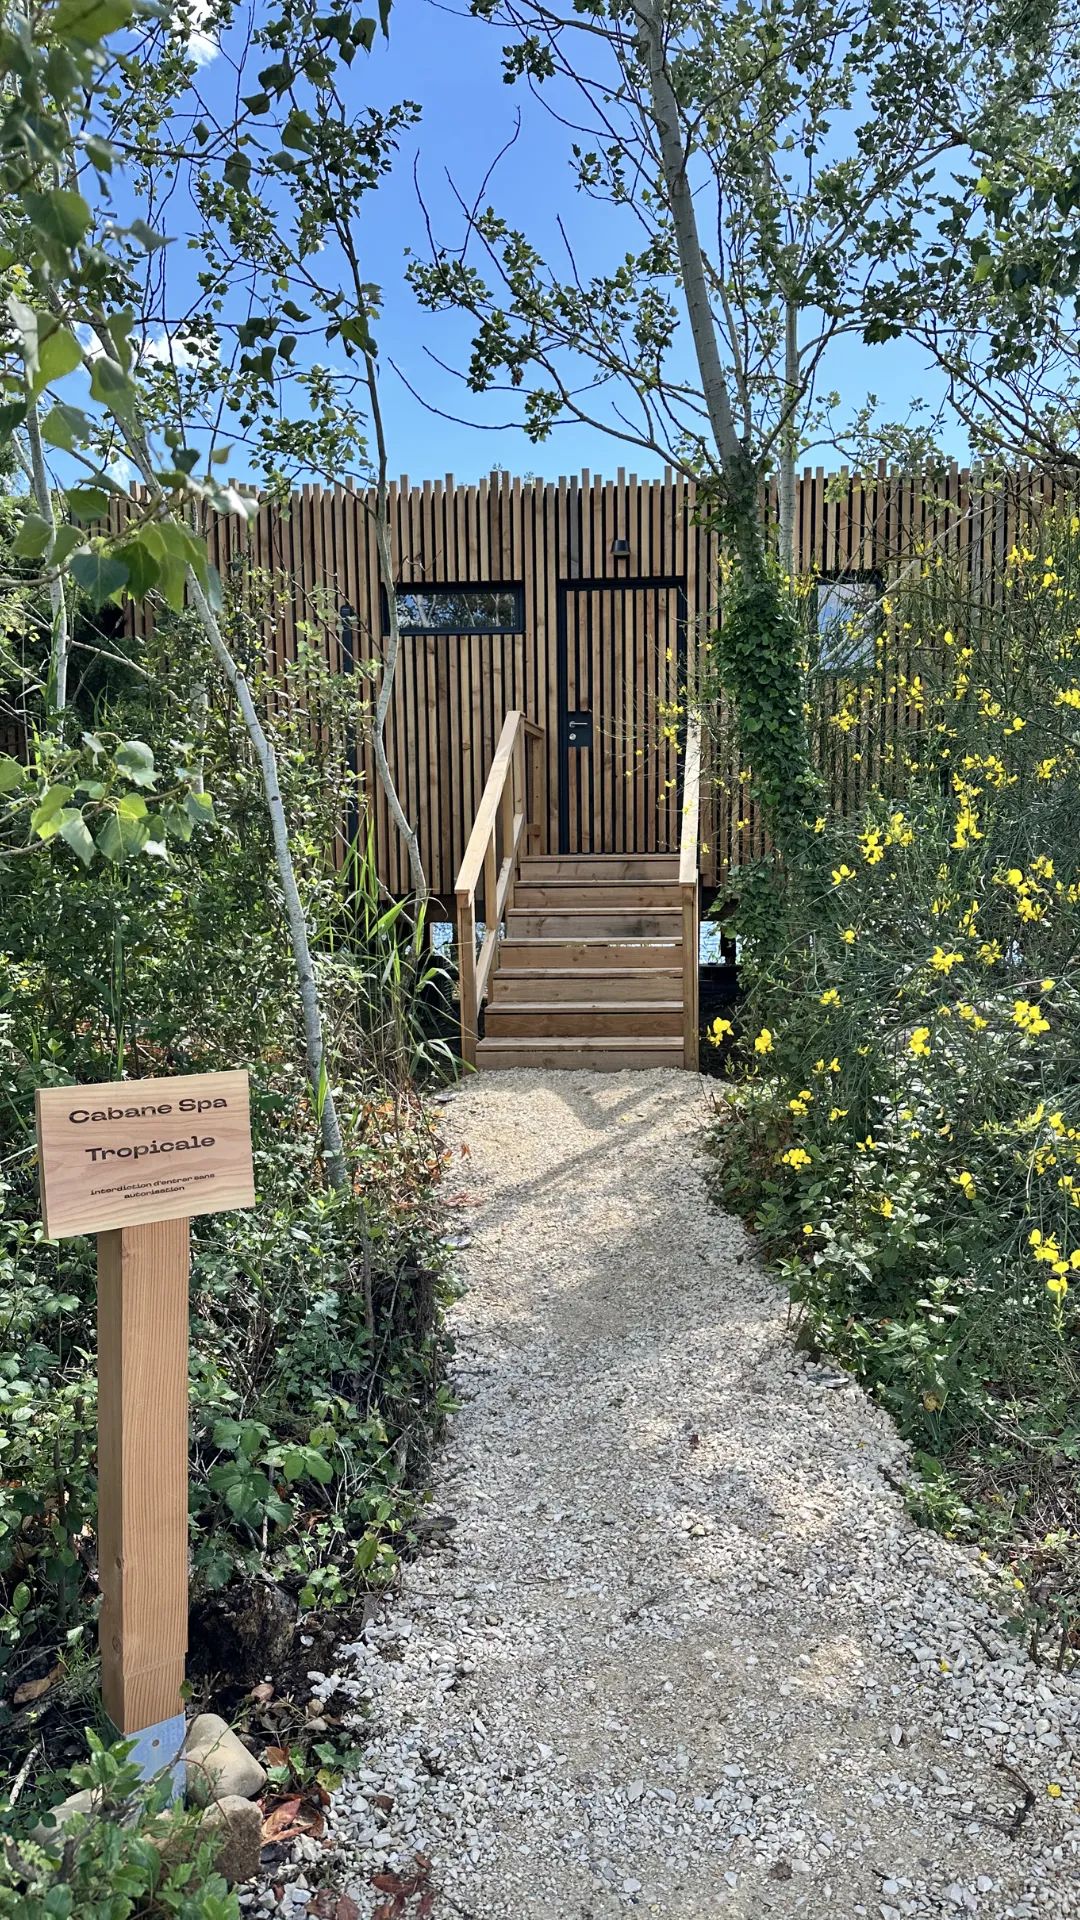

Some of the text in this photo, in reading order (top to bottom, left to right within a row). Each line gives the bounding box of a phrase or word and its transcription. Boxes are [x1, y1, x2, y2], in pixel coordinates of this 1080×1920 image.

[69, 1098, 228, 1124] Cabane Spa
[85, 1136, 215, 1162] Tropicale
[153, 1176, 193, 1187] d'entrer
[194, 1173, 215, 1181] sans
[124, 1185, 185, 1199] autorisation
